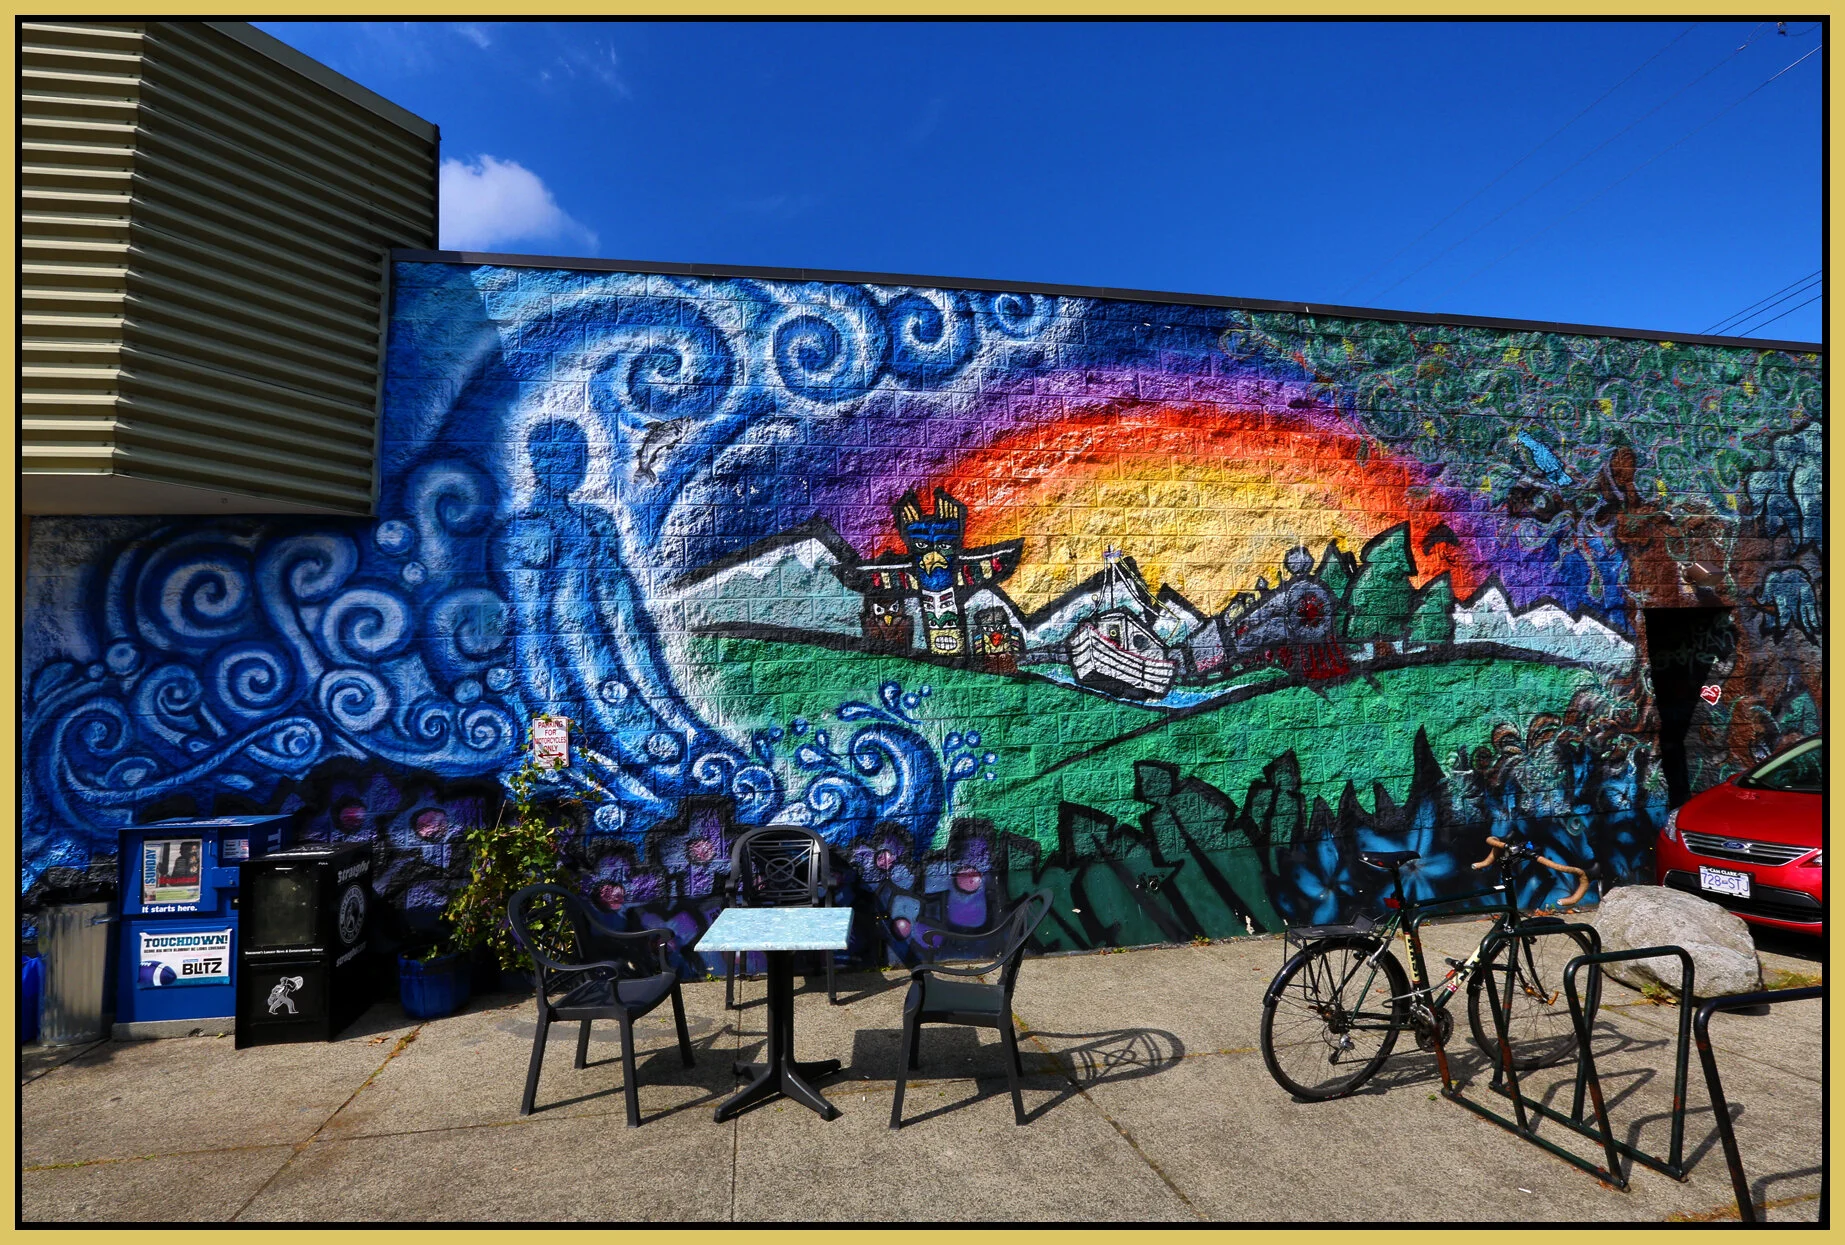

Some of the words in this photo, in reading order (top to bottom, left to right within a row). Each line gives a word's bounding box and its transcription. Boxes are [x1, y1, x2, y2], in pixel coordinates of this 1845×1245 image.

[145, 849, 156, 884] SUNDAY
[1701, 873, 1721, 886] 728
[1728, 878, 1749, 892] STJ
[151, 905, 175, 913] starts
[178, 904, 198, 912] here.
[144, 935, 228, 948] TOUCHDOWN!
[182, 961, 222, 975] BLITZ
